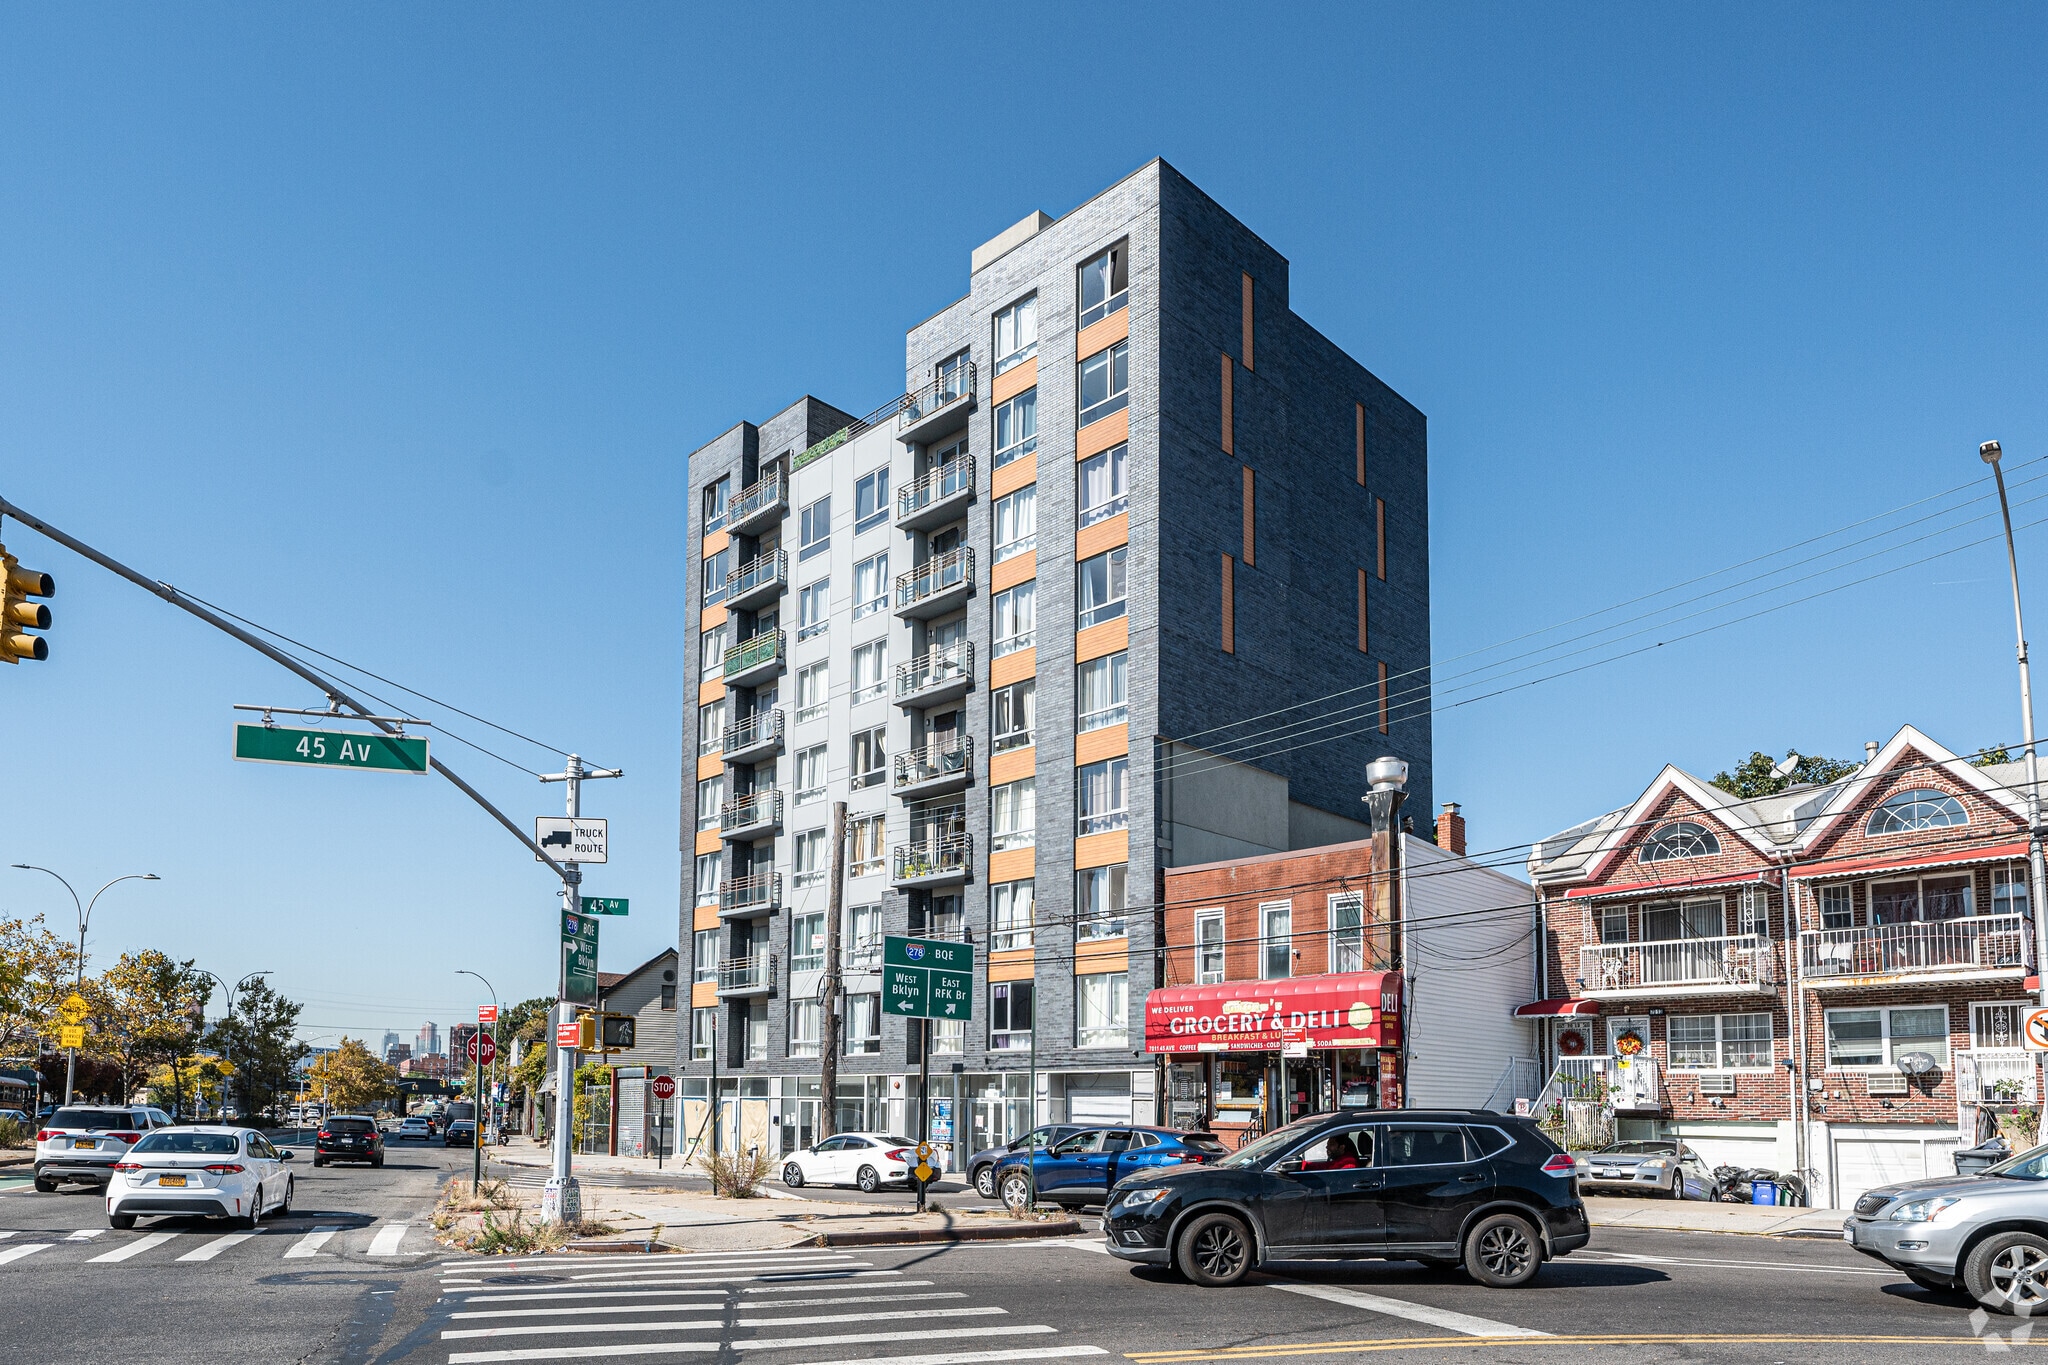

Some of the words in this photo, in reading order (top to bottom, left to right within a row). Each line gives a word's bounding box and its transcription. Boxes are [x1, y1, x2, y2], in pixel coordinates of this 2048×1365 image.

[295, 736, 326, 759] 45
[339, 739, 371, 762] Av
[575, 828, 603, 838] TRUCK
[575, 844, 603, 853] ROUTE
[590, 899, 604, 912] 45
[609, 900, 619, 908] Av
[568, 920, 578, 931] 278
[583, 922, 595, 936] BQE
[580, 941, 593, 954] WEST
[908, 947, 923, 957] 278
[935, 949, 954, 960] BQE
[578, 954, 594, 970] Bklyn
[895, 972, 917, 984] WEST
[942, 977, 960, 988] EAST
[892, 984, 919, 998] Bklyn
[935, 988, 952, 999] RFK
[956, 990, 967, 1000] Br
[1381, 993, 1398, 1013] DELI
[1164, 1005, 1194, 1014] DELIVER
[1170, 1014, 1265, 1034] GROCERY
[1270, 1011, 1284, 1030] &
[1291, 1010, 1339, 1029] DELI
[1211, 1032, 1260, 1041] BREAKFAST
[1261, 1032, 1268, 1040] &
[469, 1042, 494, 1056] SOP
[653, 1082, 675, 1093] STOP
